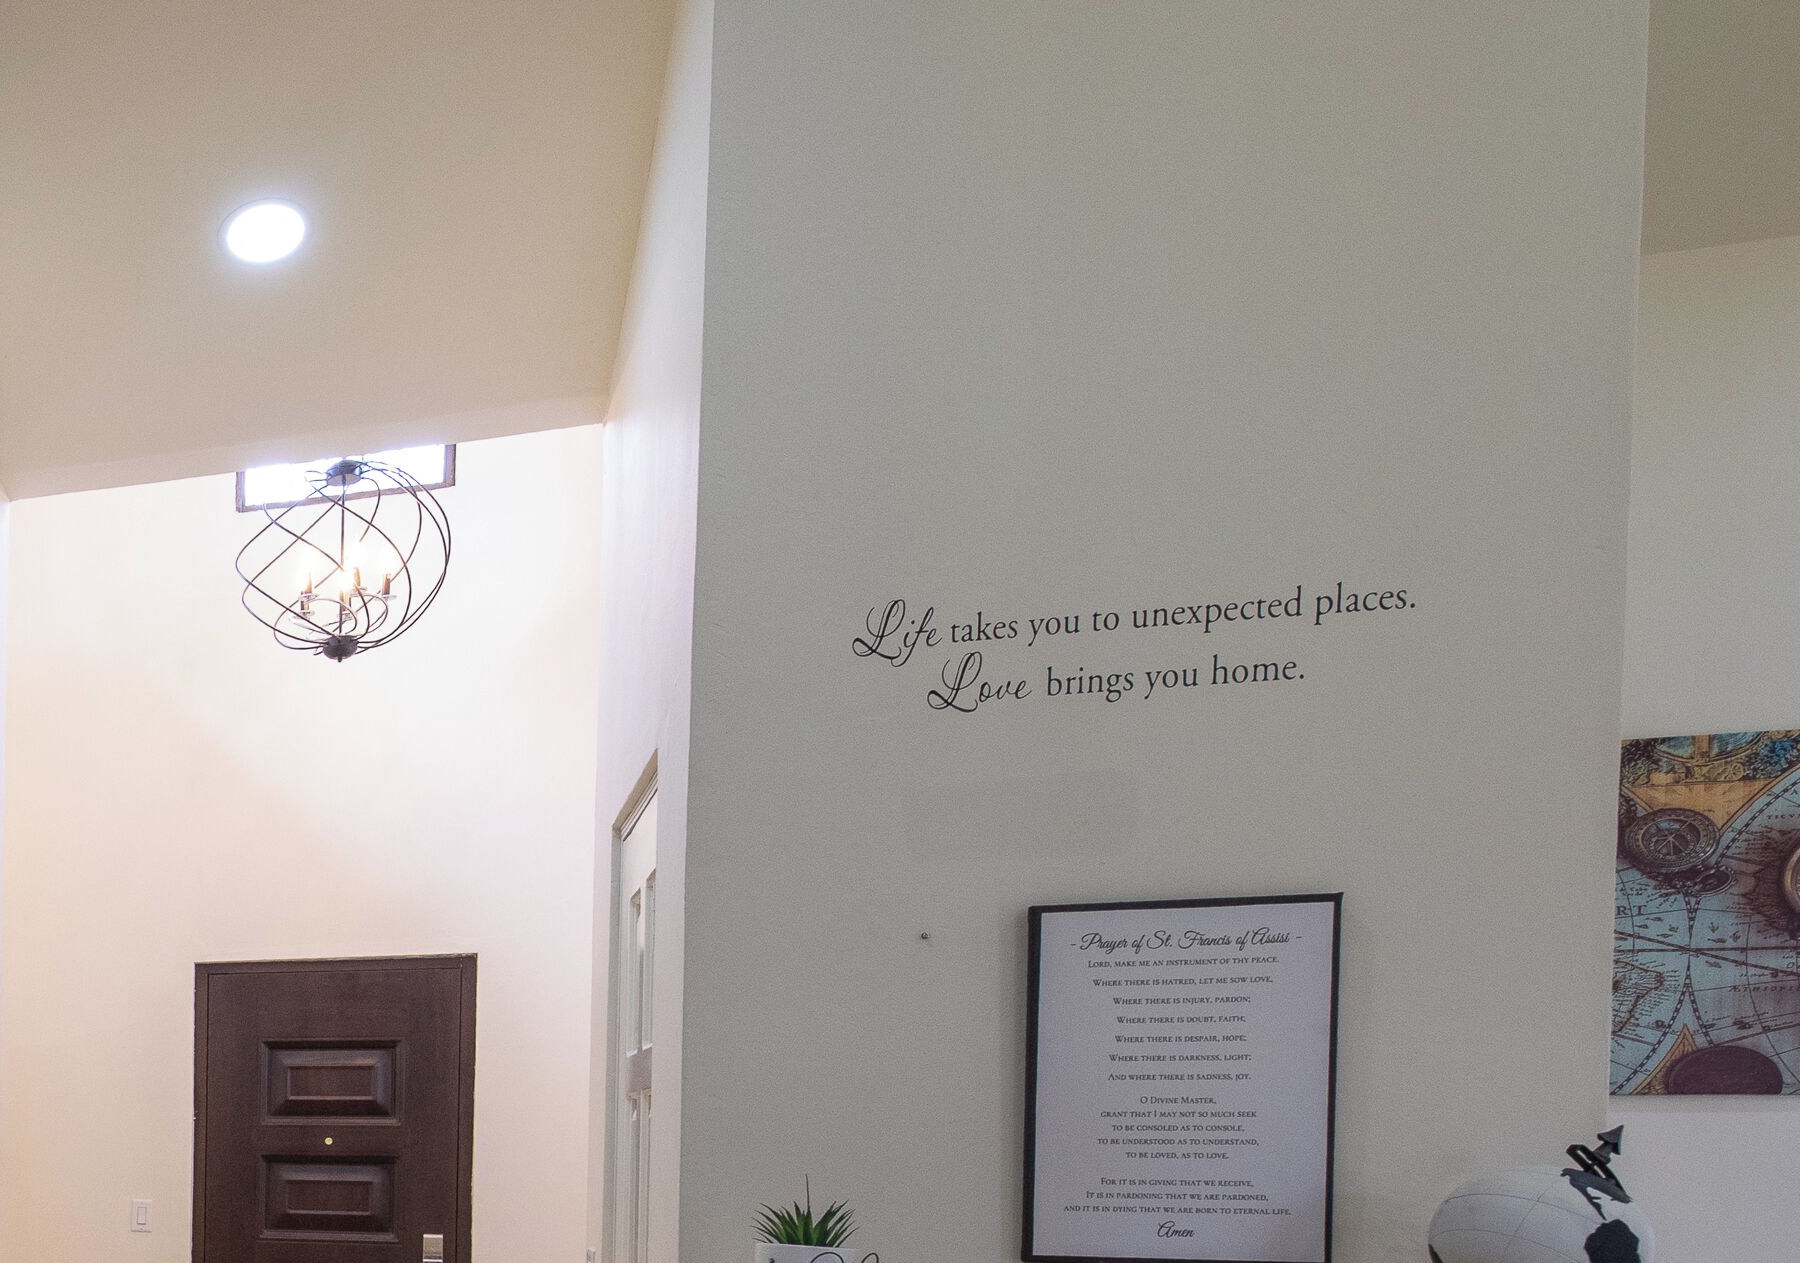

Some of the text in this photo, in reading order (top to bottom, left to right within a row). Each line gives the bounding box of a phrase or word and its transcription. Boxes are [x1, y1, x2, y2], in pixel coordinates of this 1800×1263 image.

[851, 581, 1416, 667] Life takes you to unexpected places.
[927, 651, 1305, 714] Love brings you home.
[1080, 927, 1290, 955] Prayer of St. Francis of Assisi
[1157, 1220, 1195, 1239] Amen
